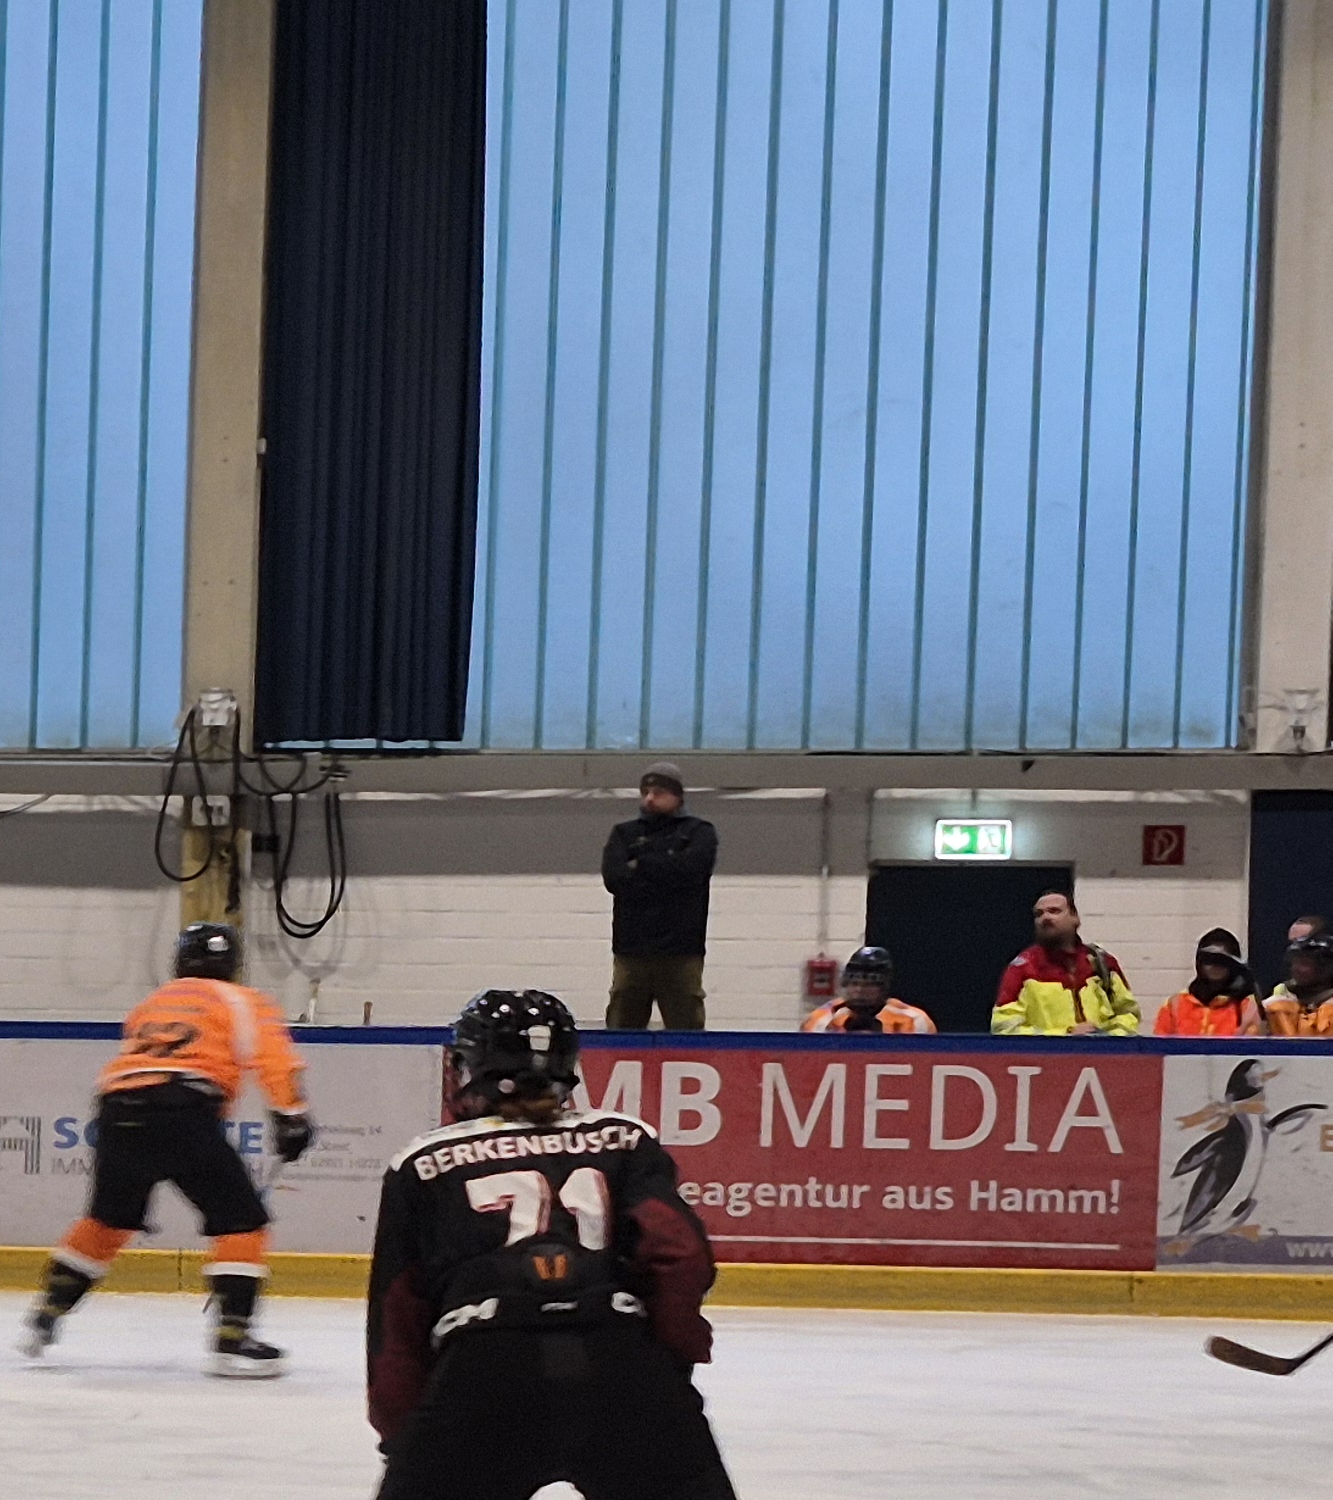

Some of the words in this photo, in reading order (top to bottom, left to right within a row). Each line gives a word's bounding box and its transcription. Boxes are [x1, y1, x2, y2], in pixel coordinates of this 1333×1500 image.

[759, 1062, 1124, 1156] MEDIA
[413, 1126, 643, 1181] BERKENBUSCH
[464, 1167, 612, 1250] 71
[882, 1184, 955, 1211] aus
[969, 1179, 1122, 1215] Hamm!
